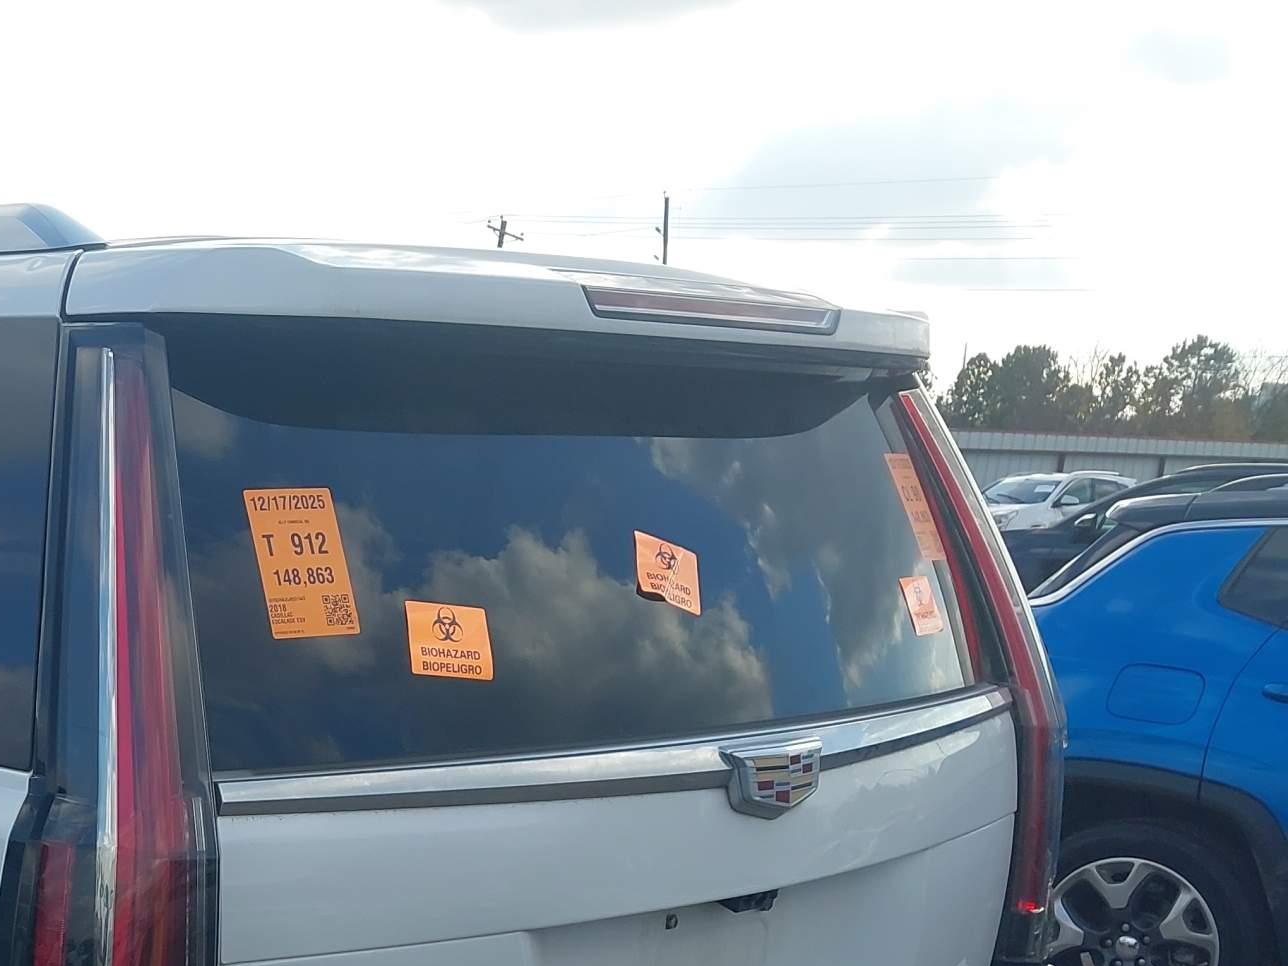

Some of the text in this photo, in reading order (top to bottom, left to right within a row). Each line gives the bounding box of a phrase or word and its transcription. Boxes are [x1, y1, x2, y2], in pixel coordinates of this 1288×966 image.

[250, 494, 326, 512] 12/17/2025
[261, 531, 329, 557] T 912
[273, 567, 335, 587] 148,863
[269, 603, 287, 613] 2018
[420, 646, 481, 661] BIOHAZARD
[422, 661, 483, 676] BIOPELIGRO
